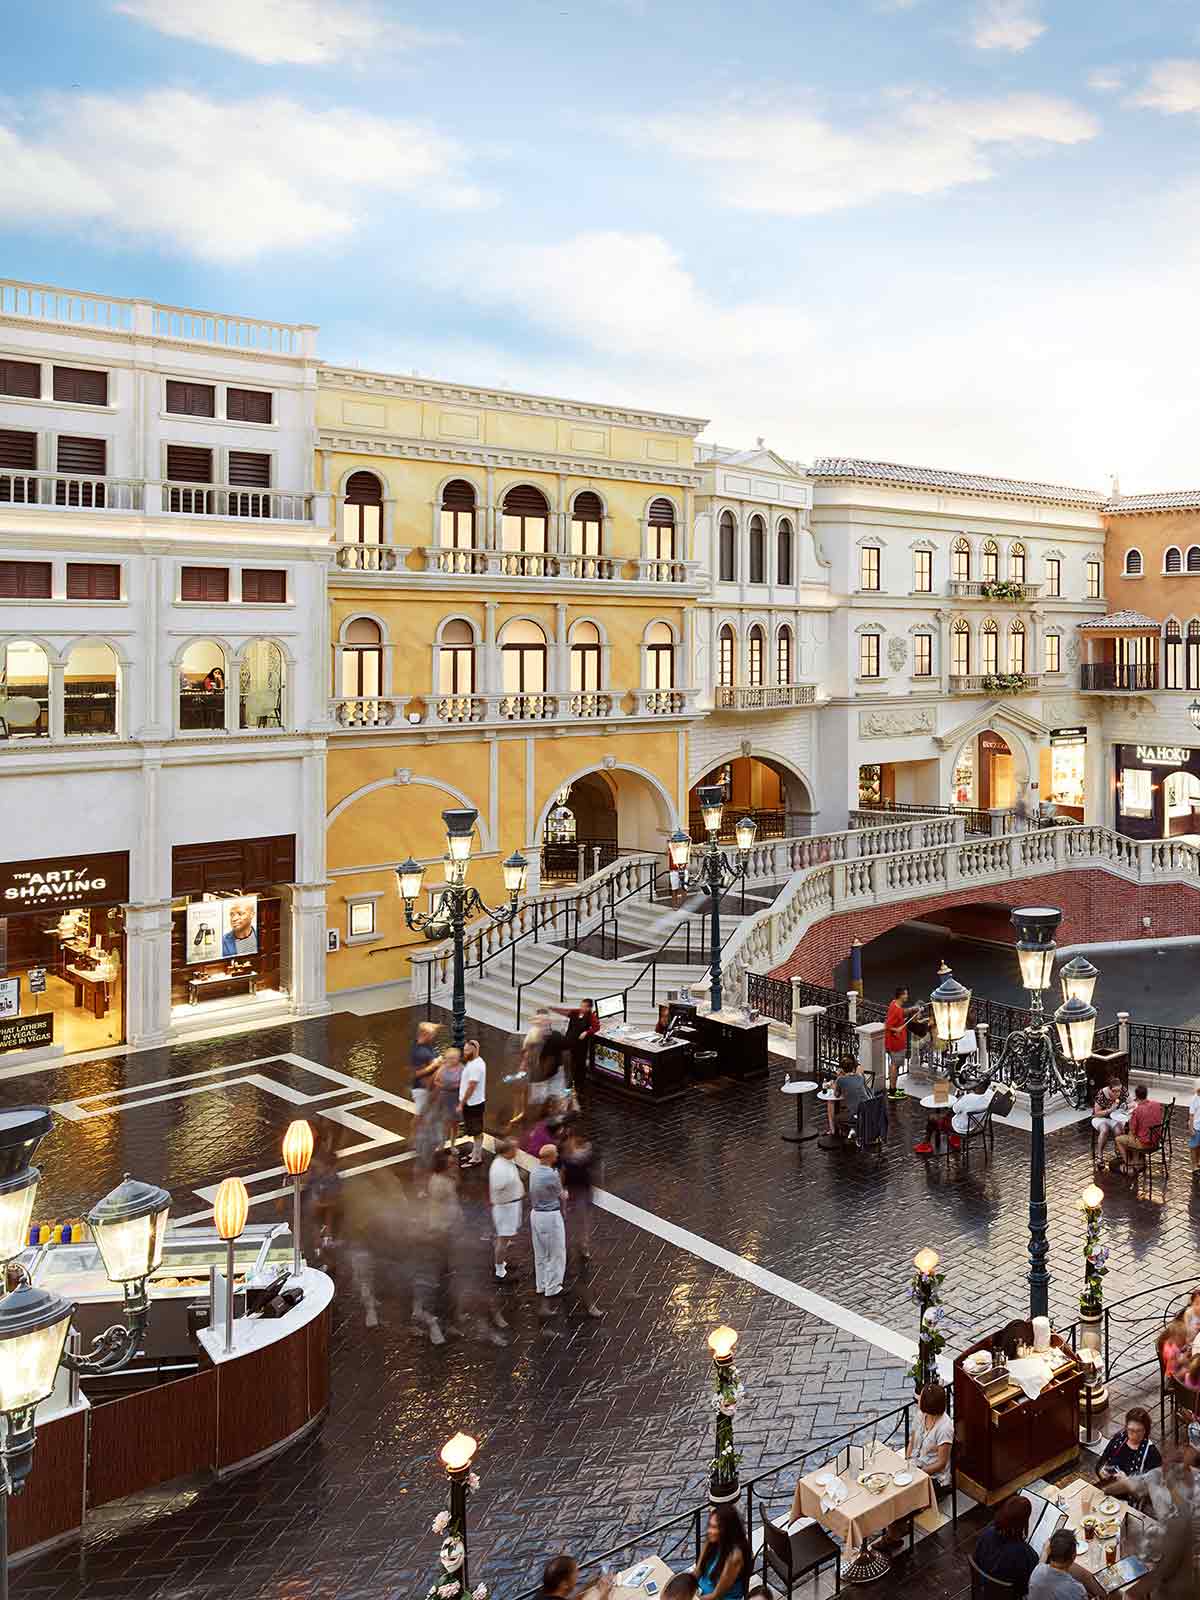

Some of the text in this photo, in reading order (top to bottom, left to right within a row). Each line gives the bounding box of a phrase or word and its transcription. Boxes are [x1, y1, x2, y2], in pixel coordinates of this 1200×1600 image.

[1136, 745, 1191, 762] NA HOKU
[28, 869, 75, 885] ART
[75, 867, 88, 880] of
[4, 878, 107, 900] SHAVING
[0, 1021, 47, 1035] HAT LATHERS
